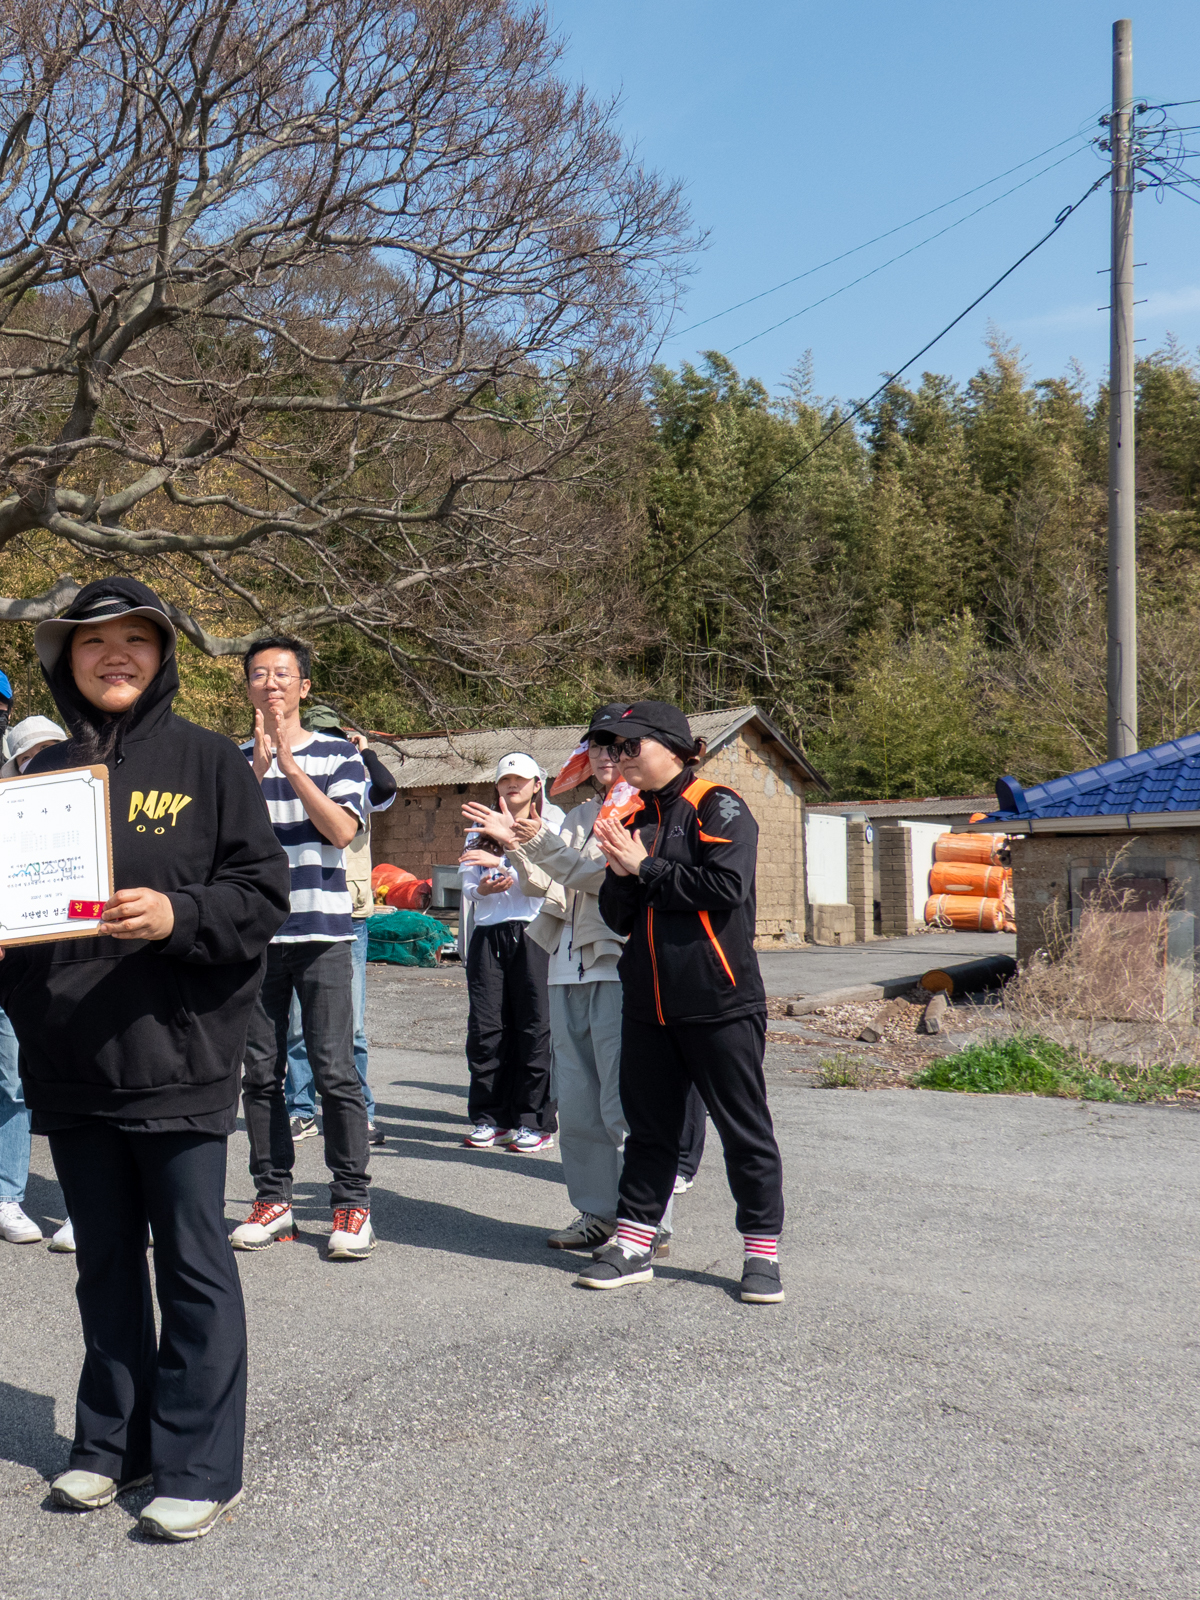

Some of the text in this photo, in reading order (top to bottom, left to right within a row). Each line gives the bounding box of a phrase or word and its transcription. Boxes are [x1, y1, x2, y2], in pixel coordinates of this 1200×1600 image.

[128, 790, 192, 826] DARK
[21, 907, 70, 920] 사단법인 섬즈
